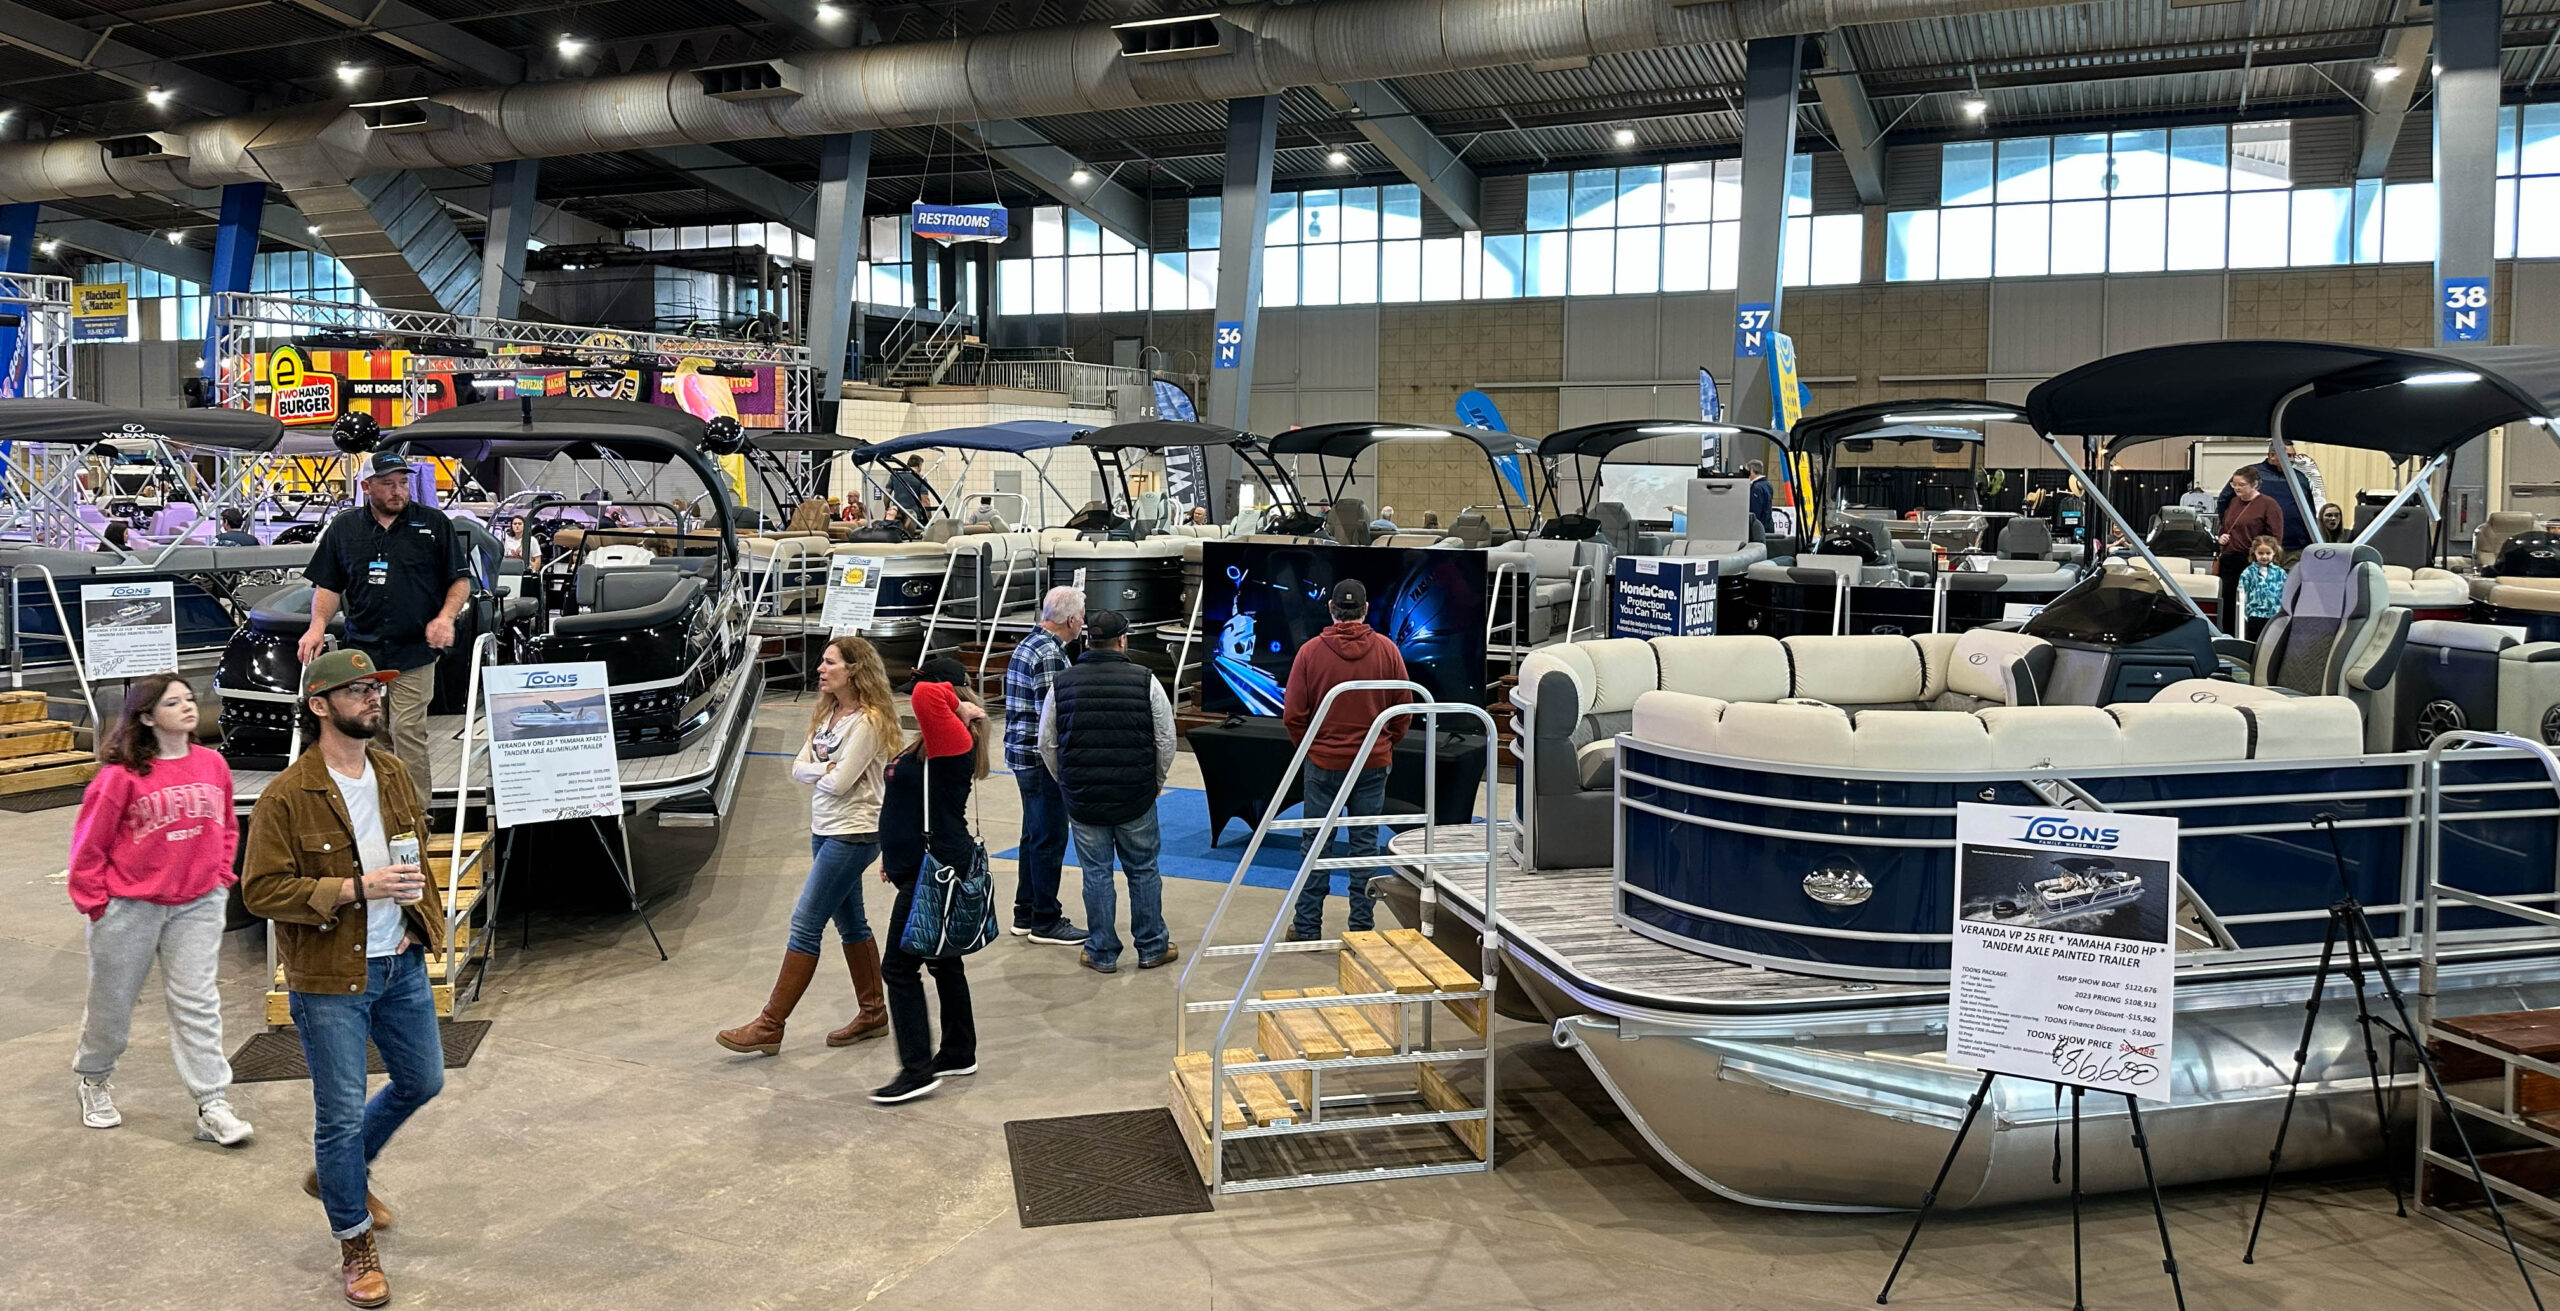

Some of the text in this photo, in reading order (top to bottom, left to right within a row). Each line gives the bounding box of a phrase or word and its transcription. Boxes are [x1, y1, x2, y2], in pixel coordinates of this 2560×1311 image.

[918, 212, 990, 228] RESTROOMS
[89, 301, 113, 310] Marine
[2445, 286, 2487, 308] 38
[1739, 310, 1771, 330] 37
[2455, 311, 2476, 330] N
[1217, 328, 1242, 344] 36
[1745, 331, 1761, 348] N
[1222, 346, 1234, 360] N
[278, 385, 330, 400] TWO HANDS
[354, 384, 402, 394] HOT DOGS
[280, 396, 330, 416] BURGER
[102, 432, 172, 440] VERANDA
[110, 586, 151, 597] TOONS
[1620, 580, 1677, 600] HondaCare.
[1684, 579, 1716, 604] New Honda
[1620, 604, 1672, 620] You Can Trust.
[1627, 596, 1665, 610] Protection
[1686, 601, 1714, 626] BF350 V8
[520, 671, 578, 688] TOONS
[2014, 815, 2120, 844] TOONS
[1961, 924, 2006, 938] VERANDA
[2009, 930, 2022, 940] VP
[2024, 932, 2036, 941] 25
[2038, 934, 2055, 944] RFL
[2066, 937, 2110, 952] YAMAHA
[2114, 943, 2139, 954] F300
[2142, 946, 2156, 956] HP
[1982, 940, 2140, 968] TANDEM AXLE PAINTED TRAILER
[2057, 975, 2157, 994] MSRP SHOW BOAT $122,676
[2093, 994, 2121, 1004] PRICING
[2124, 998, 2157, 1008] $108,913
[2075, 1006, 2093, 1015] Carry
[2094, 1008, 2124, 1018] Discount
[2126, 1013, 2156, 1024] -$15,962
[2044, 1016, 2156, 1038] TOONS Finance Discount -$3,000
[2027, 1030, 2056, 1041] TOONS
[2058, 1034, 2085, 1045] SHOW
[2088, 1039, 2113, 1050] PRICE
